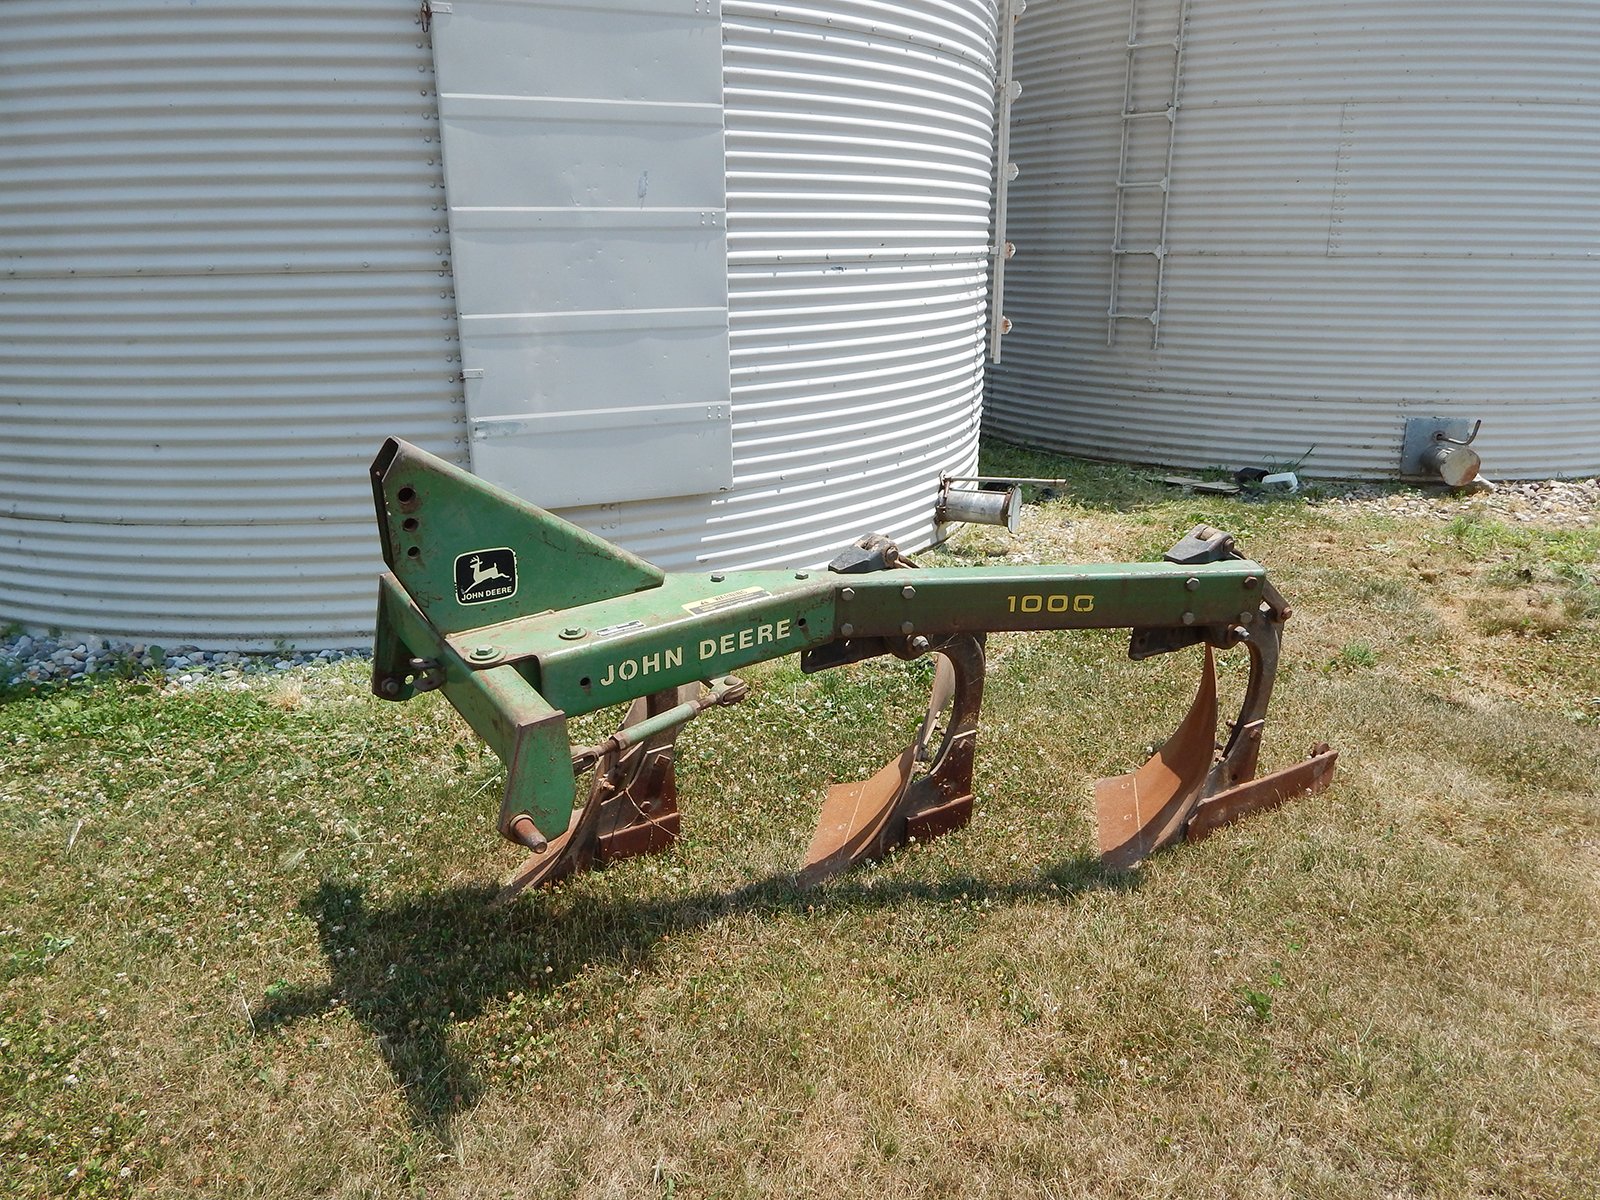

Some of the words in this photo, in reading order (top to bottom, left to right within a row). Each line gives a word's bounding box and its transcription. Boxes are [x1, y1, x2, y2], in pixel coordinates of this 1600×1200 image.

[461, 591, 484, 601] JOHN
[485, 586, 512, 597] DEERE
[1007, 594, 1095, 613] 1000
[600, 647, 684, 686] JOHN
[699, 618, 791, 660] DEERE
